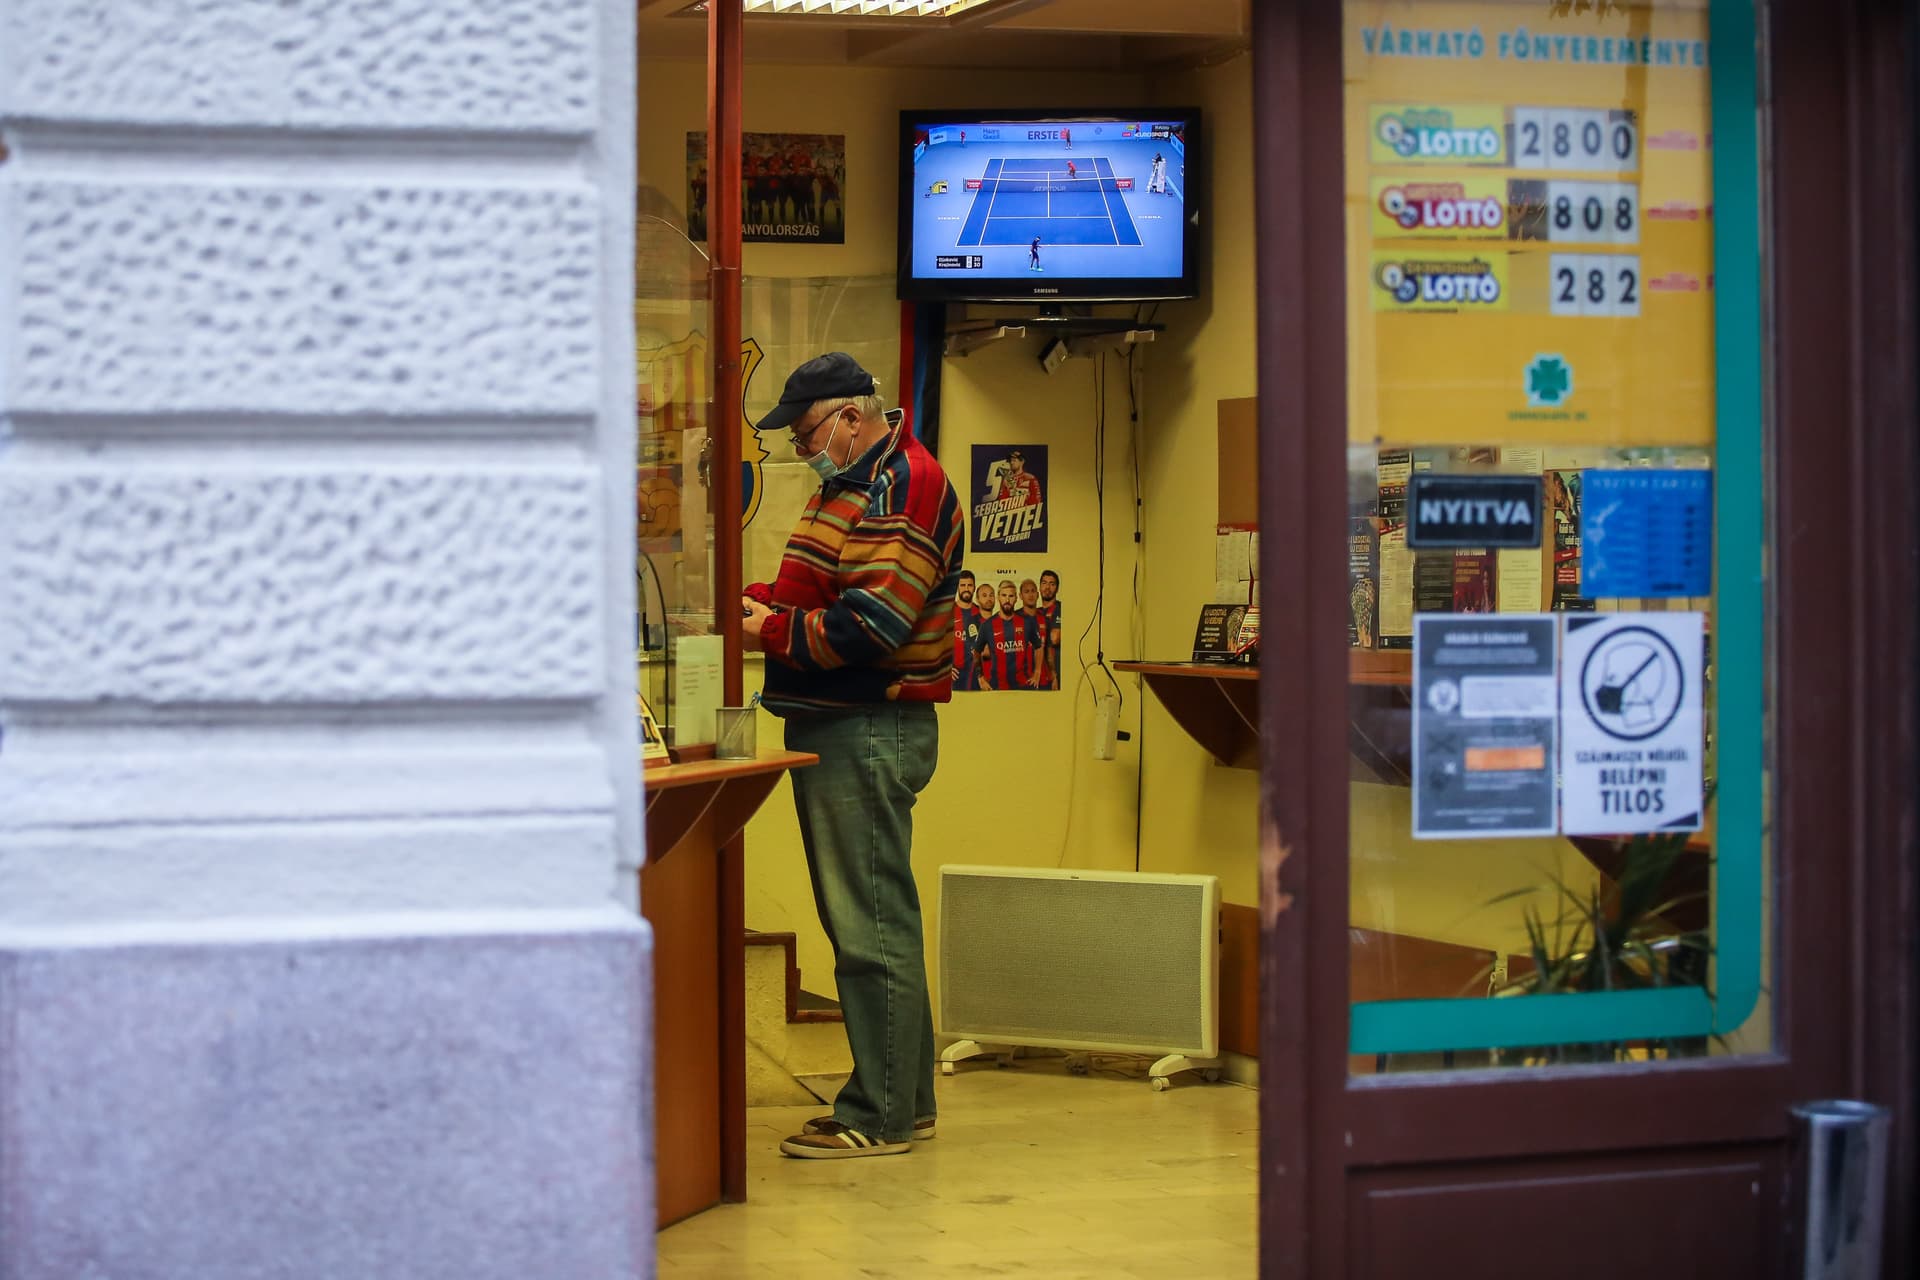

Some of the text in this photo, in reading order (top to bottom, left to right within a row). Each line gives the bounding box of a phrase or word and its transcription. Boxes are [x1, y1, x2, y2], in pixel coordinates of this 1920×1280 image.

[1361, 24, 1710, 66] VÁRHATÓ FŐNYEREMÉNYE
[1027, 130, 1059, 140] ERSTE
[1418, 126, 1499, 156] LOTTÓ
[1522, 121, 1633, 160] 2800
[1423, 197, 1502, 228] LOTTÓ
[1554, 196, 1634, 231] 808
[741, 222, 820, 237] ANYOLORSZÁG
[1422, 273, 1498, 301] LOTTÓ
[1557, 268, 1637, 304] 282
[973, 494, 1028, 518] SEBASTIAN
[1420, 500, 1531, 525] NYITVA
[979, 502, 1044, 542] VETTEL
[996, 640, 1023, 651] QATAR
[1599, 764, 1666, 785] BELÉPNI
[1600, 788, 1665, 814] TILOS
